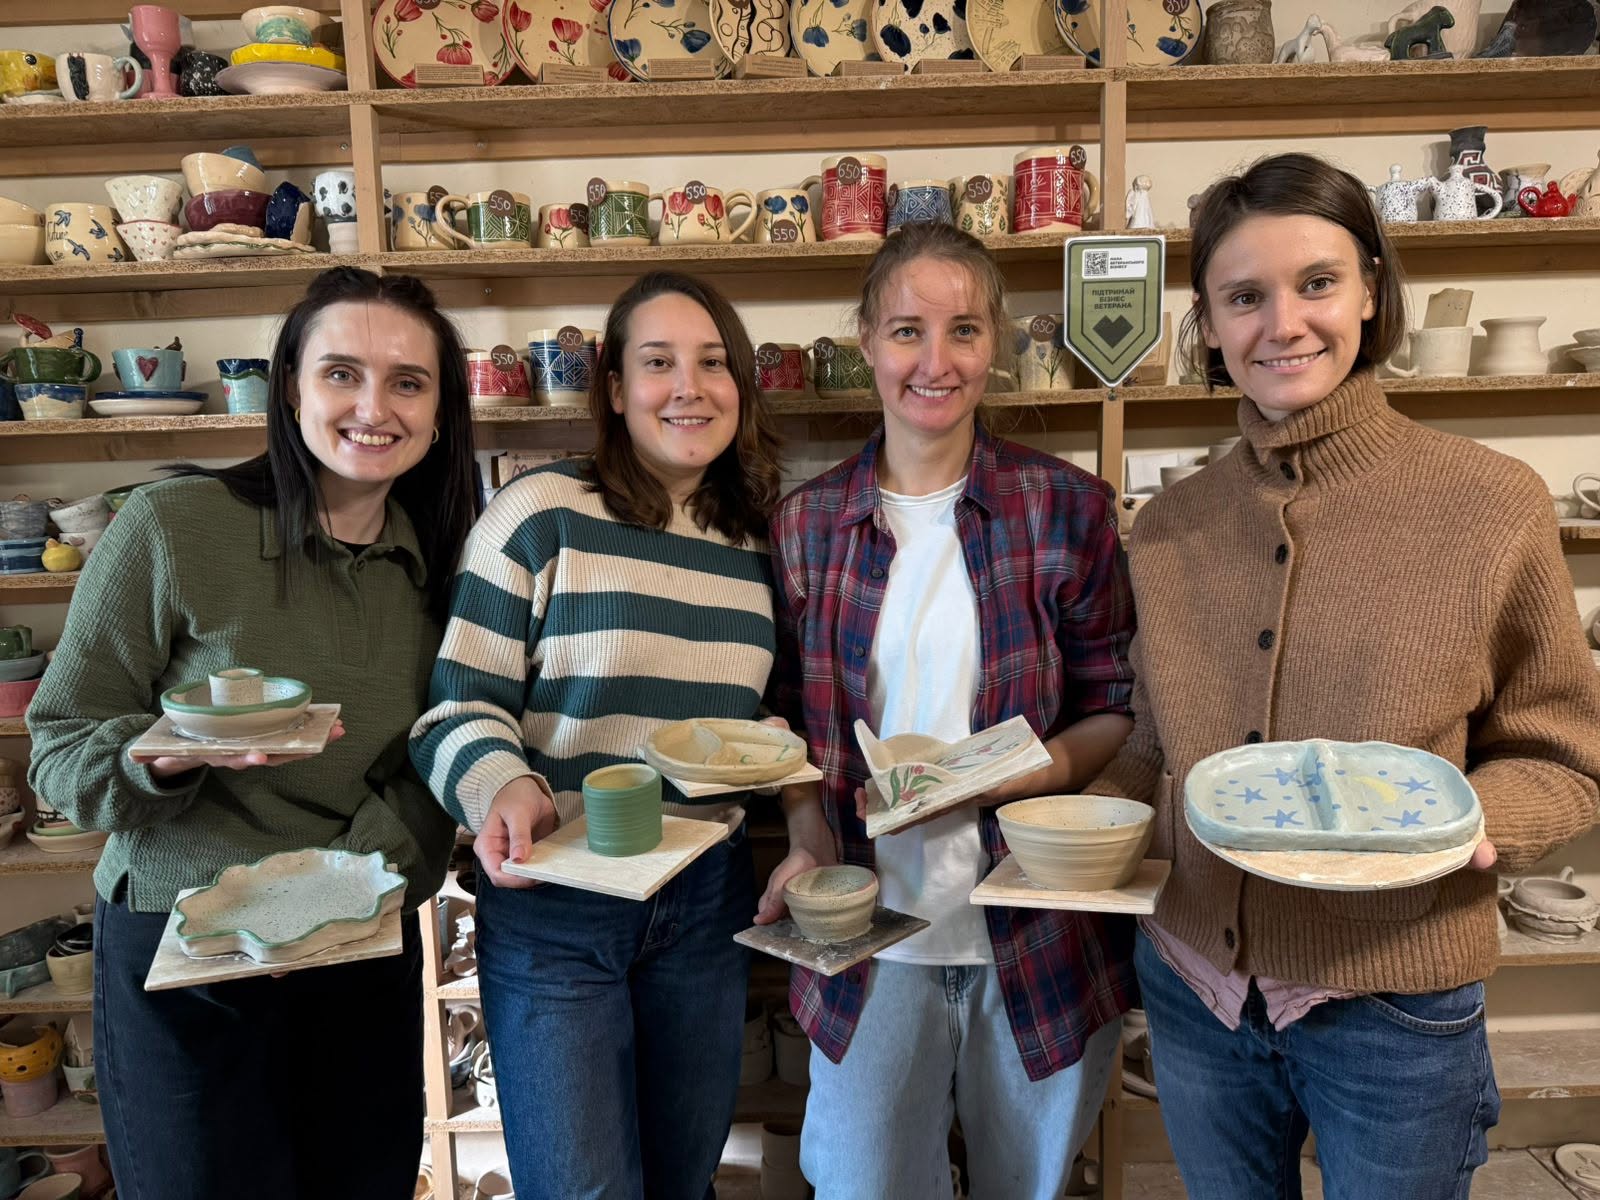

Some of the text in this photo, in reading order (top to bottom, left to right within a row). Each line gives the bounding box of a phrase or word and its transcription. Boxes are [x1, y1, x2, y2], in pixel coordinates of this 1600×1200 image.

[838, 162, 861, 179] 650
[588, 184, 606, 202] 550
[685, 185, 706, 200] 550
[968, 179, 991, 198] 550
[429, 191, 445, 206] 55
[489, 194, 511, 210] 550
[773, 228, 796, 241] 550
[1092, 288, 1135, 296] ПІДТРИМАЙ
[1032, 319, 1056, 334] 650
[559, 332, 583, 346] 650
[758, 350, 782, 365] 550
[815, 342, 835, 359] 550
[492, 352, 515, 366] 550
